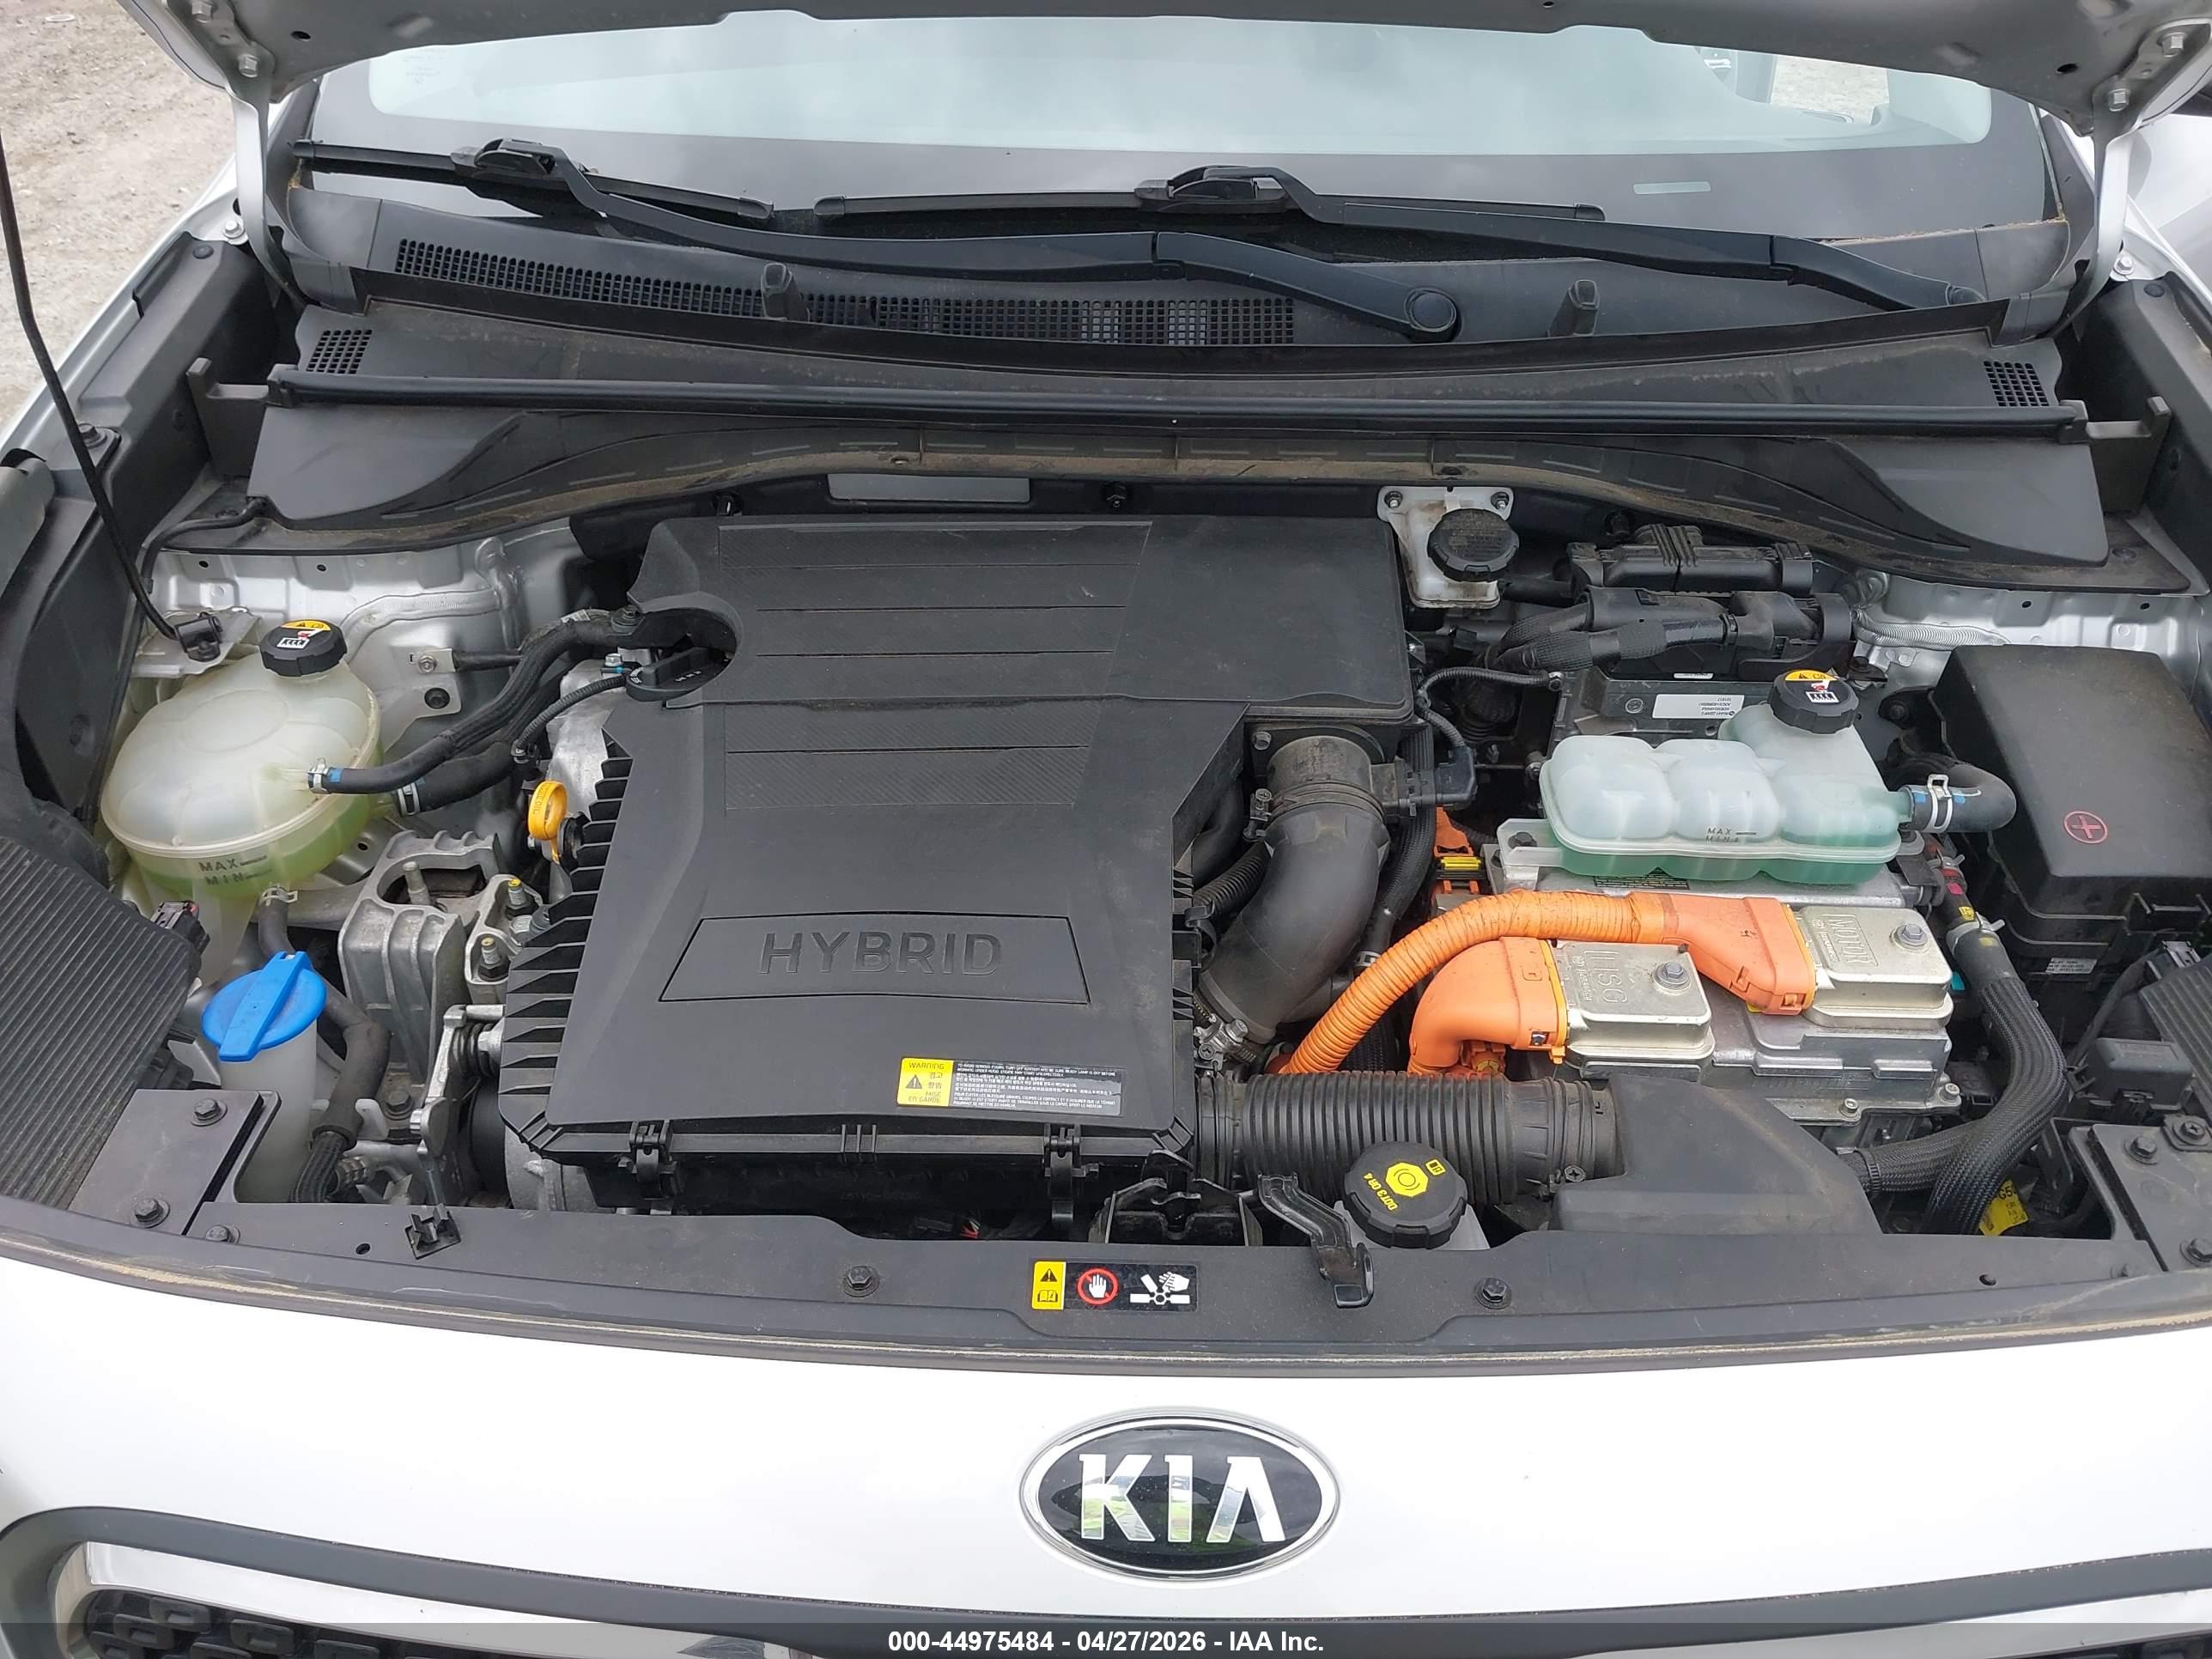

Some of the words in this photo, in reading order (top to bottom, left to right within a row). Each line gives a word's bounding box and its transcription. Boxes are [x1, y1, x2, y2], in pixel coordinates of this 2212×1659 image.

[198, 858, 239, 872] MAX
[204, 872, 244, 885] MIN
[757, 931, 1003, 976] HYBRID
[1827, 919, 1872, 963] MOTOR
[908, 1061, 945, 1070] WARNING
[1079, 1453, 1285, 1543] KIA
